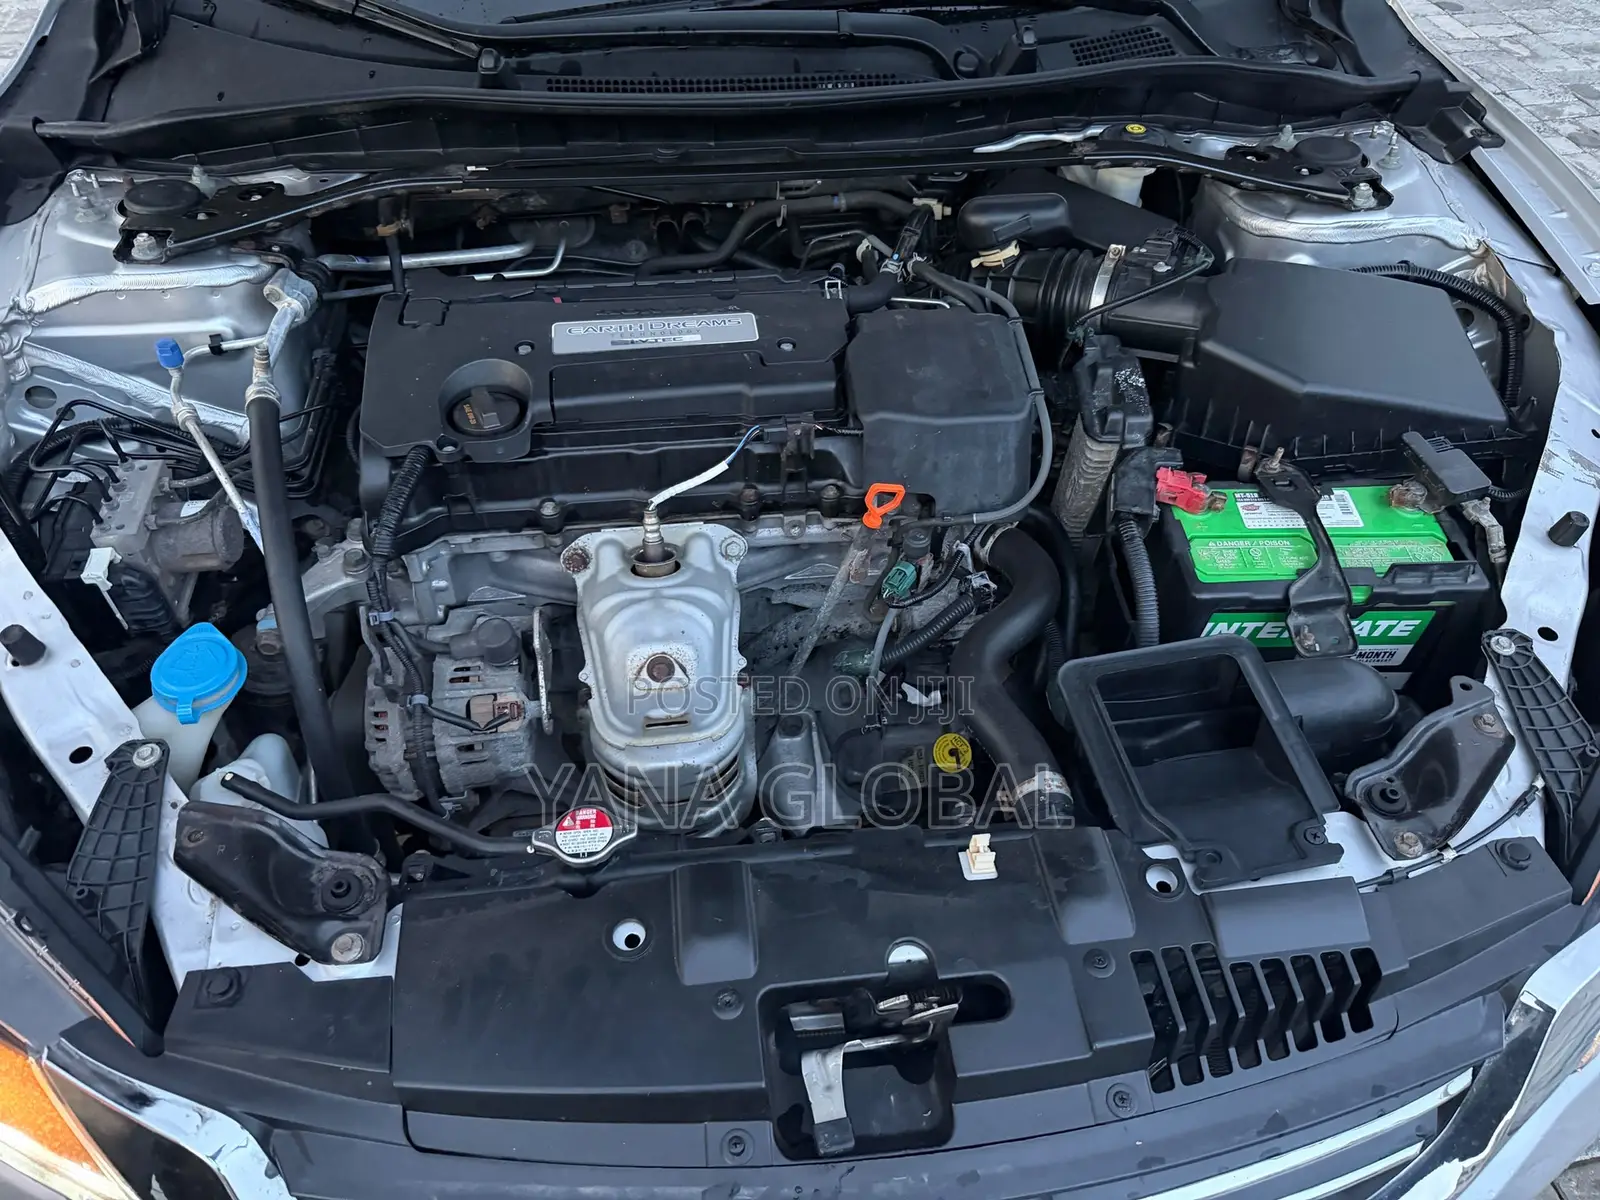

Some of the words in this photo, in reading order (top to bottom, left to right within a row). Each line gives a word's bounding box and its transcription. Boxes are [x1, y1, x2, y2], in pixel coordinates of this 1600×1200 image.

[567, 323, 644, 336] EARTH
[648, 317, 743, 331] DREAMS
[610, 329, 701, 338] TECHNOLOGY
[1200, 620, 1422, 638] INTEATE
